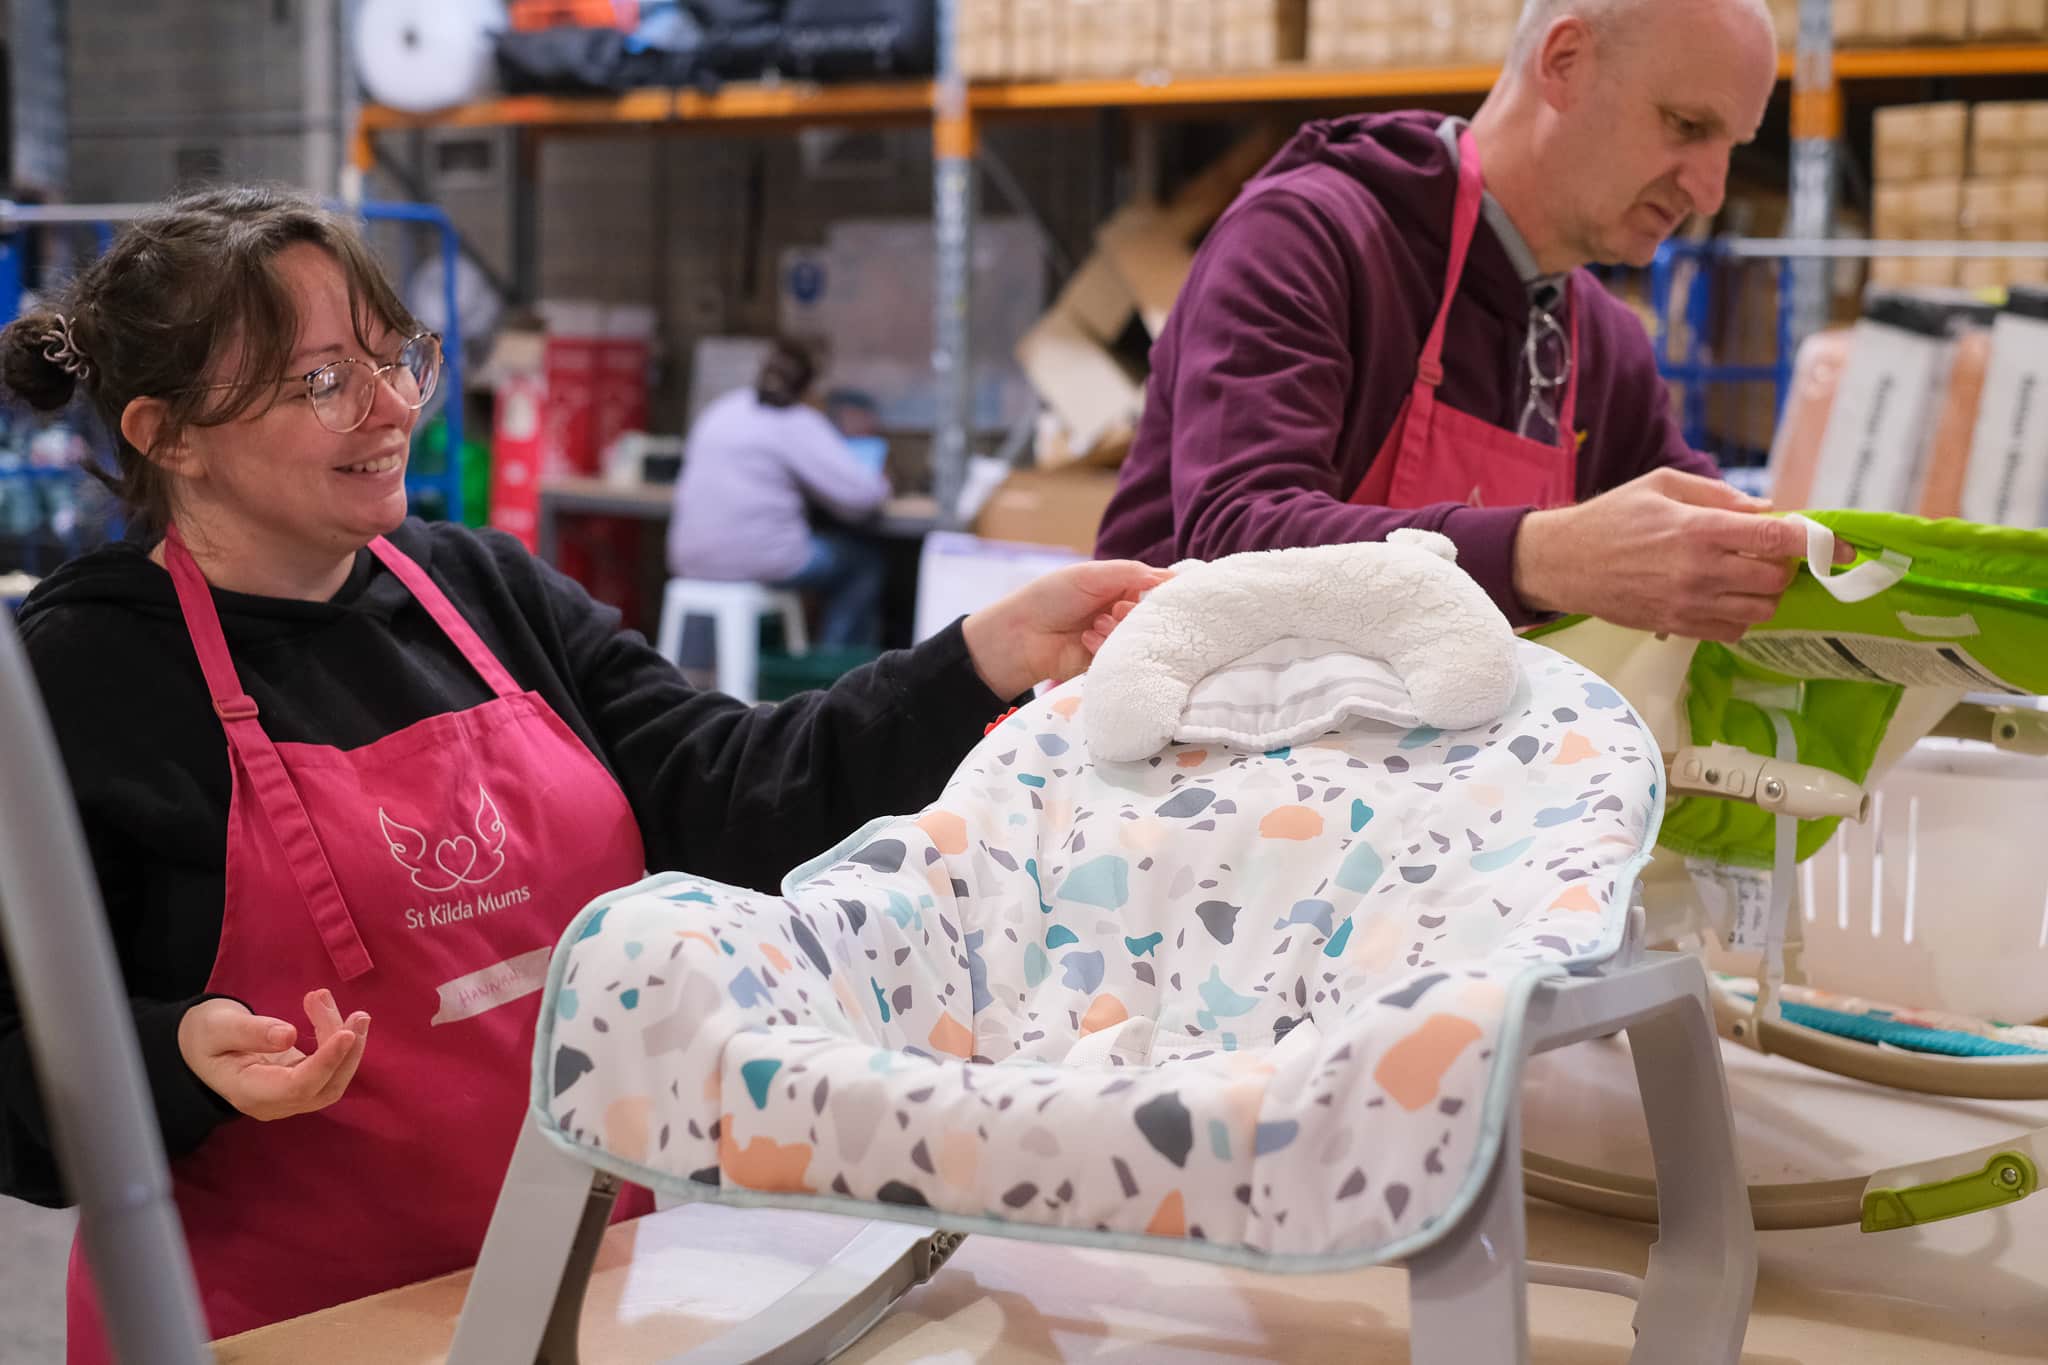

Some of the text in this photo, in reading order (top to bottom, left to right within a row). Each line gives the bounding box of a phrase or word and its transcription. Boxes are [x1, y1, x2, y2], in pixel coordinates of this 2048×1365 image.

[405, 886, 531, 929] St Kilda Mums
